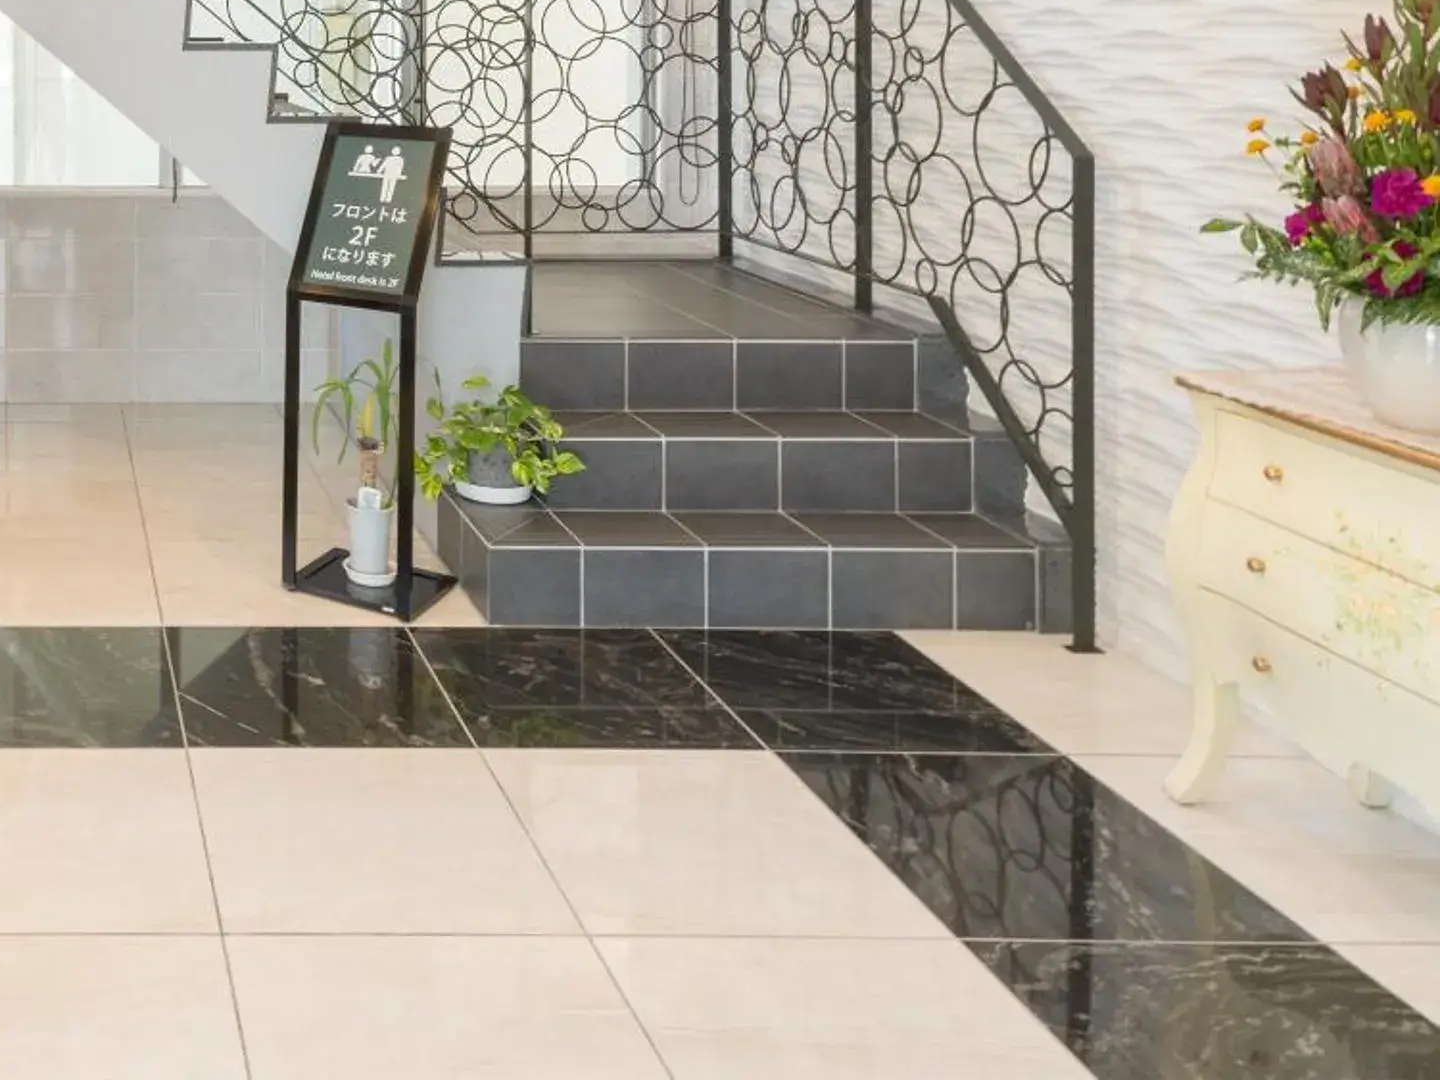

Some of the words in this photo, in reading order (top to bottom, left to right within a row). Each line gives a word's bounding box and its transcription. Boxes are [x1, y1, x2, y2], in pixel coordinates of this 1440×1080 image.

[331, 204, 409, 224] フロントは
[348, 226, 379, 247] 2F
[322, 246, 397, 268] になります
